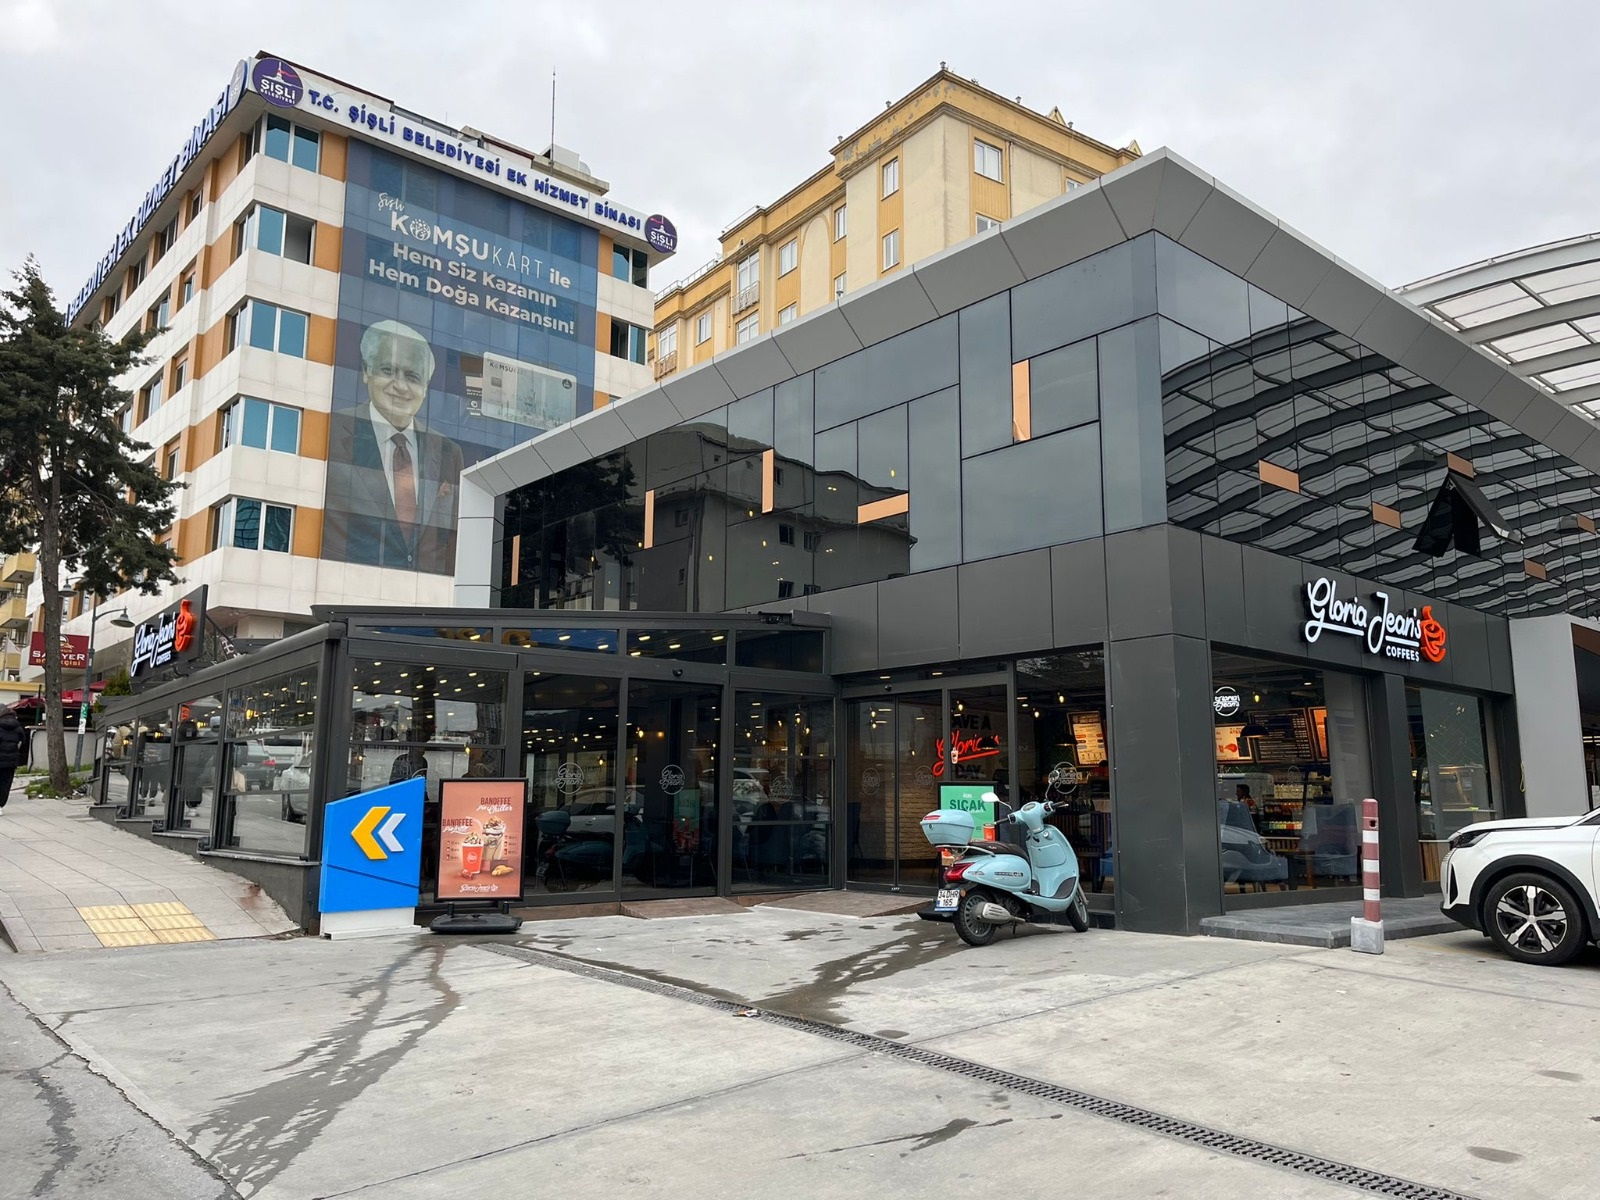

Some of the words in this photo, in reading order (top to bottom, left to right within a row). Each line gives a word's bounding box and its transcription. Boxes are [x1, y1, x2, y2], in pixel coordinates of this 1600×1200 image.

[308, 89, 339, 113] T.C.
[348, 103, 396, 135] ŞİŞLİ
[402, 126, 501, 176] BELEDİYESİ
[507, 168, 528, 187] EK
[534, 177, 589, 209] HİZMET
[594, 201, 641, 231] BİNASI
[393, 241, 443, 272] Hem
[448, 259, 478, 283] Siz
[482, 270, 557, 308] Kazanın
[549, 267, 572, 289] ile
[368, 258, 420, 289] Hem
[425, 276, 480, 307] Doğa
[485, 294, 575, 336] Kazansın!
[1304, 576, 1367, 643] Gloria
[1366, 590, 1422, 655] Jean's
[1385, 644, 1420, 662] COFFEES
[442, 818, 473, 827] BANOFFEE
[480, 797, 512, 806] BANOFFEE
